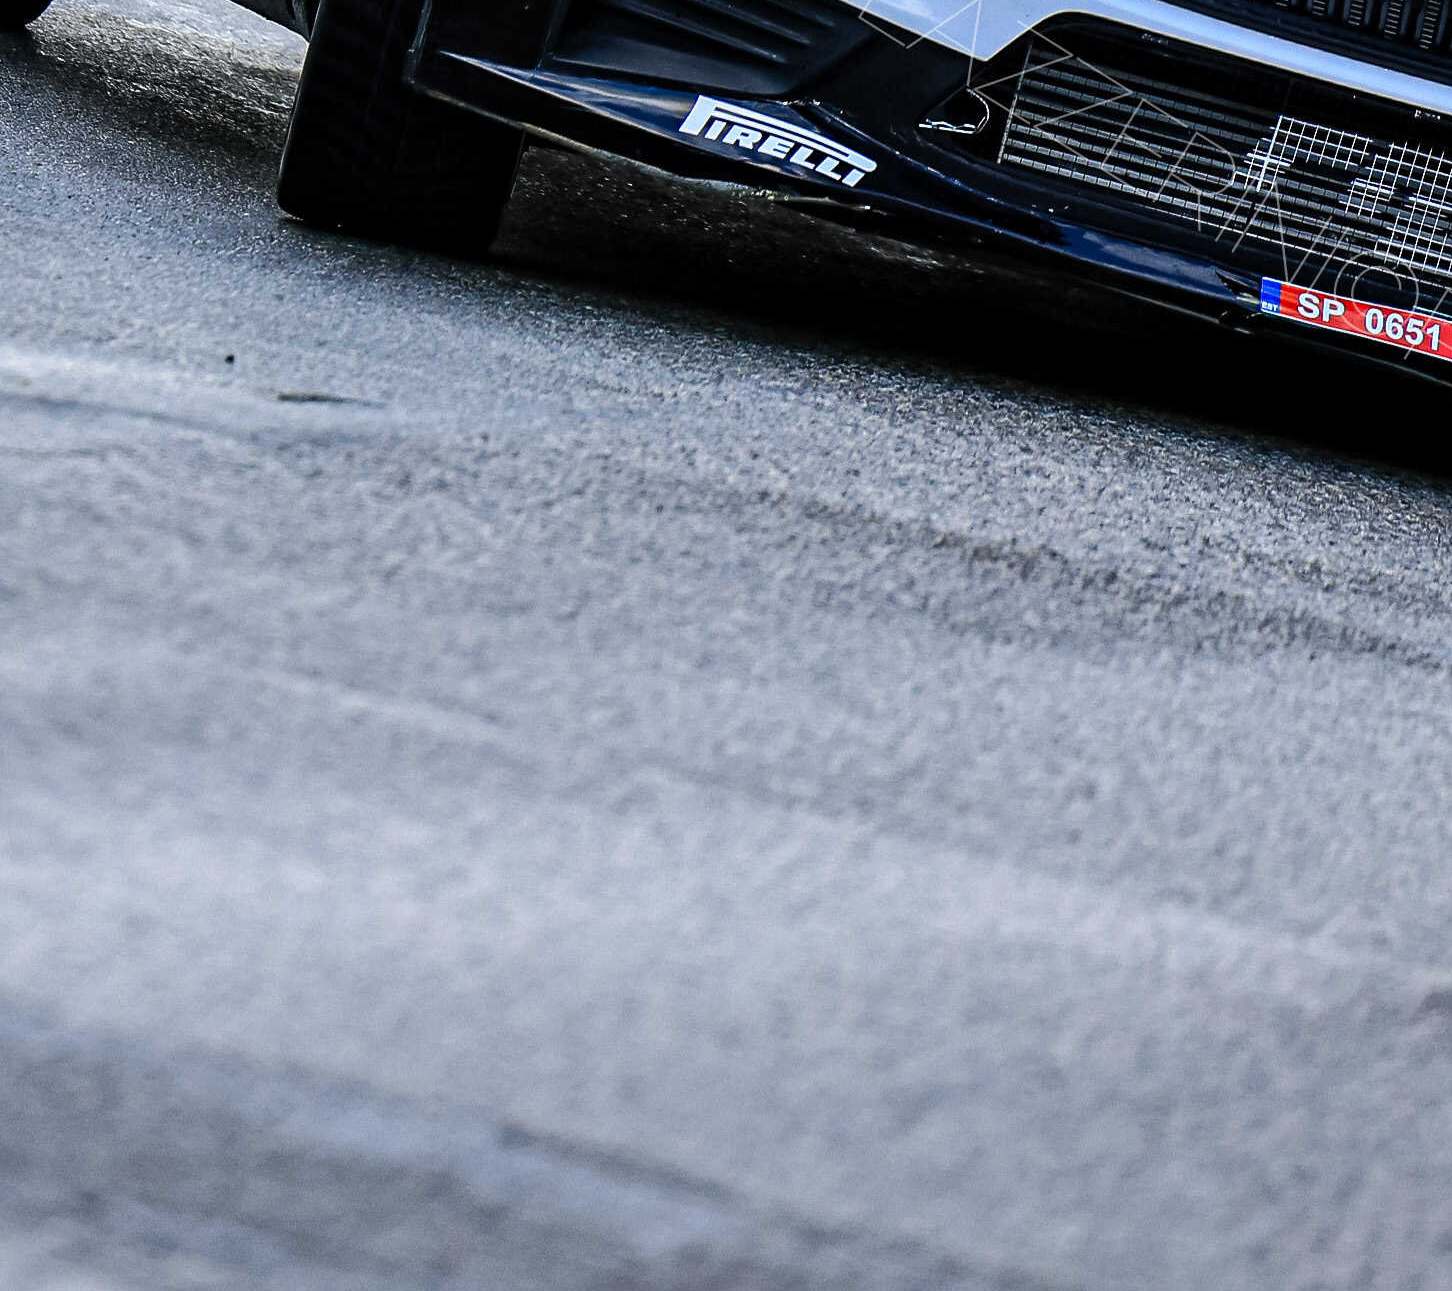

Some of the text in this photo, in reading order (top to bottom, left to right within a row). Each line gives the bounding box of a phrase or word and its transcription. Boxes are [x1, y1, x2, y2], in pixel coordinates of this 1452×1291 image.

[679, 94, 878, 188] PIRELLI
[1297, 292, 1441, 352] SP 0651
